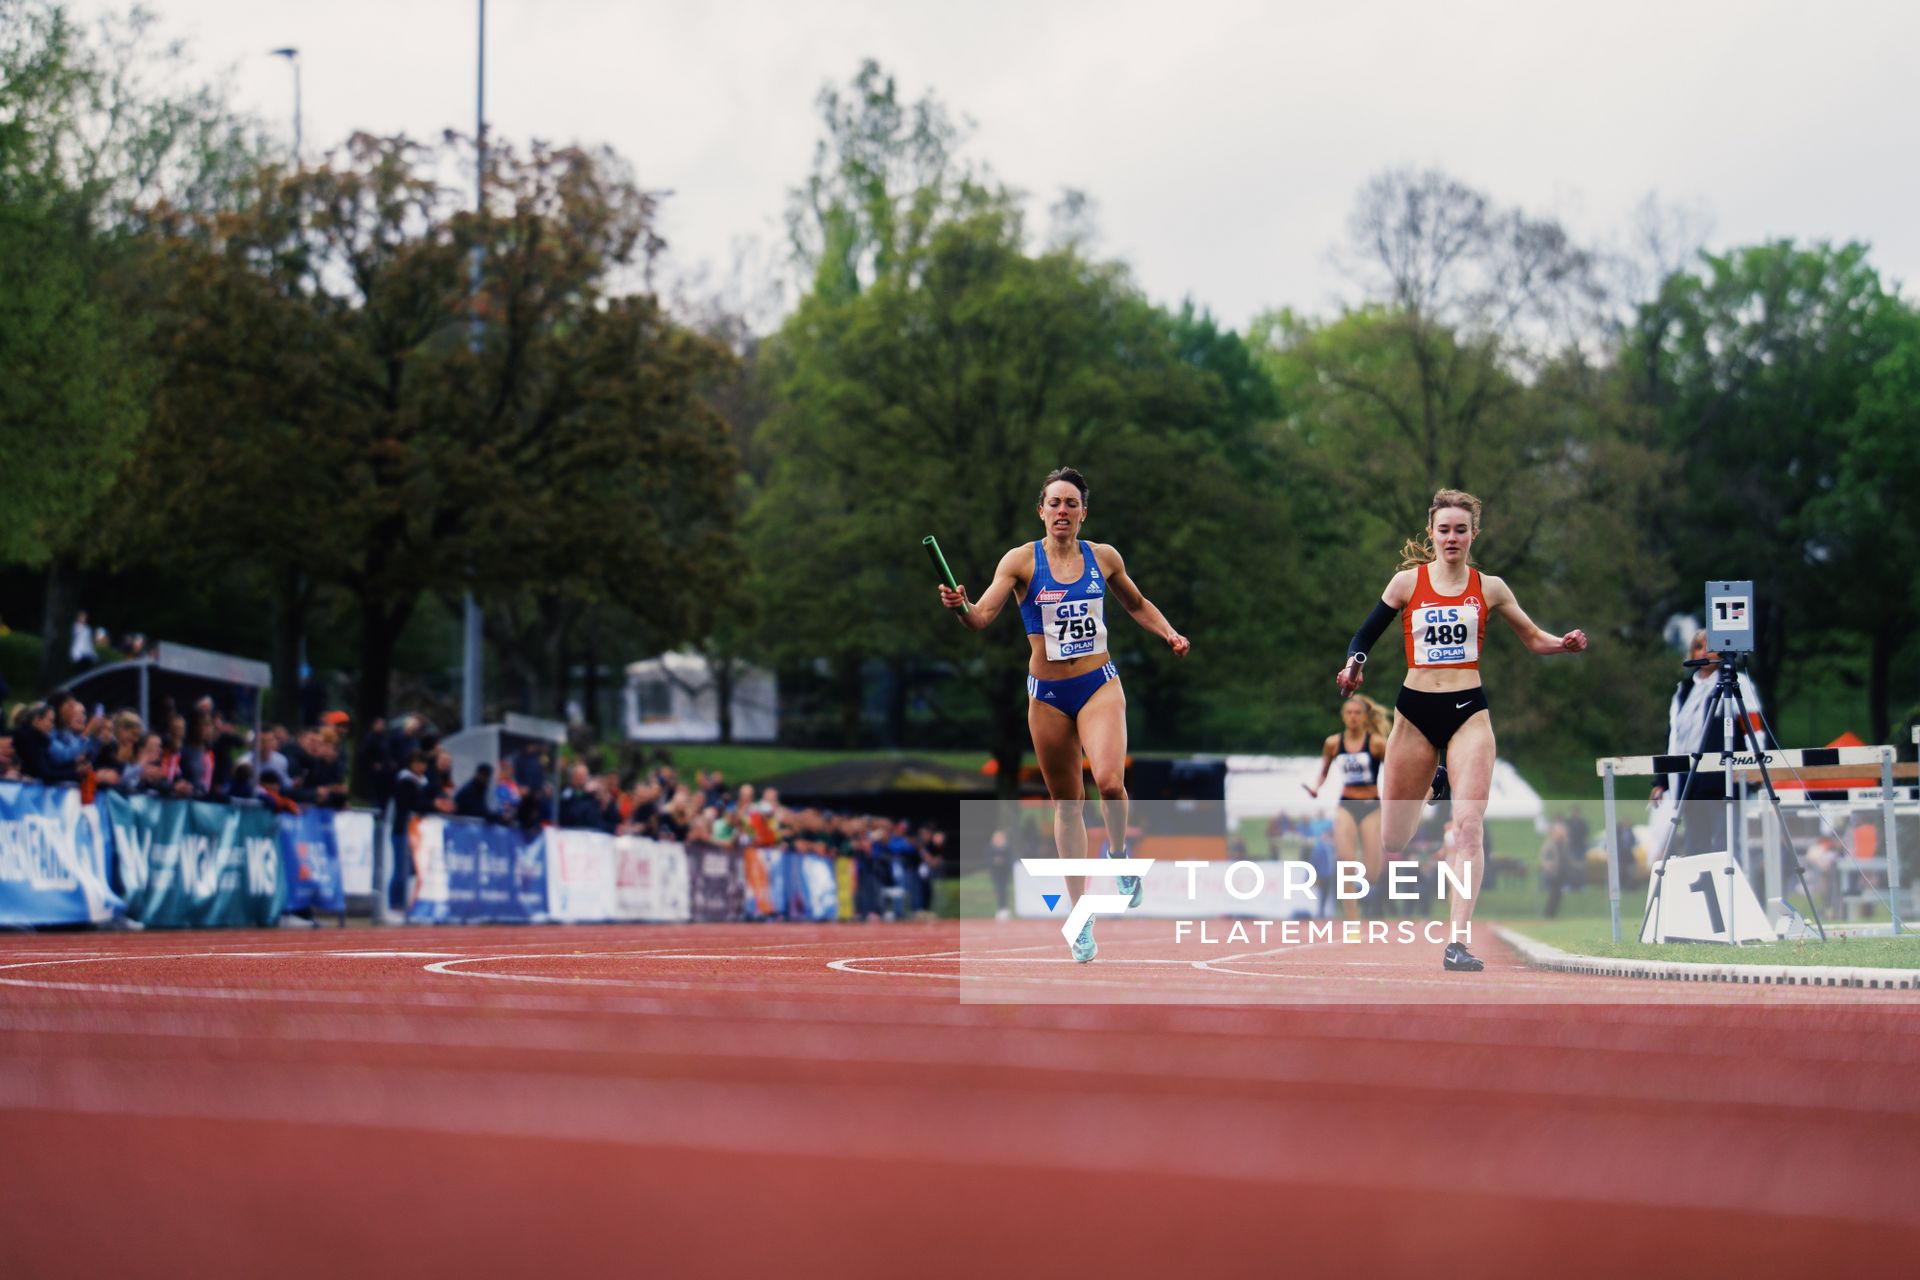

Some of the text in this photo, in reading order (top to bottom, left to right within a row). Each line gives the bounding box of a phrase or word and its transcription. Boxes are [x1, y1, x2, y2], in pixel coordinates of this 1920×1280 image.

[1055, 617, 1097, 641] 759
[1424, 624, 1467, 645] 489
[1688, 871, 1725, 934] 1
